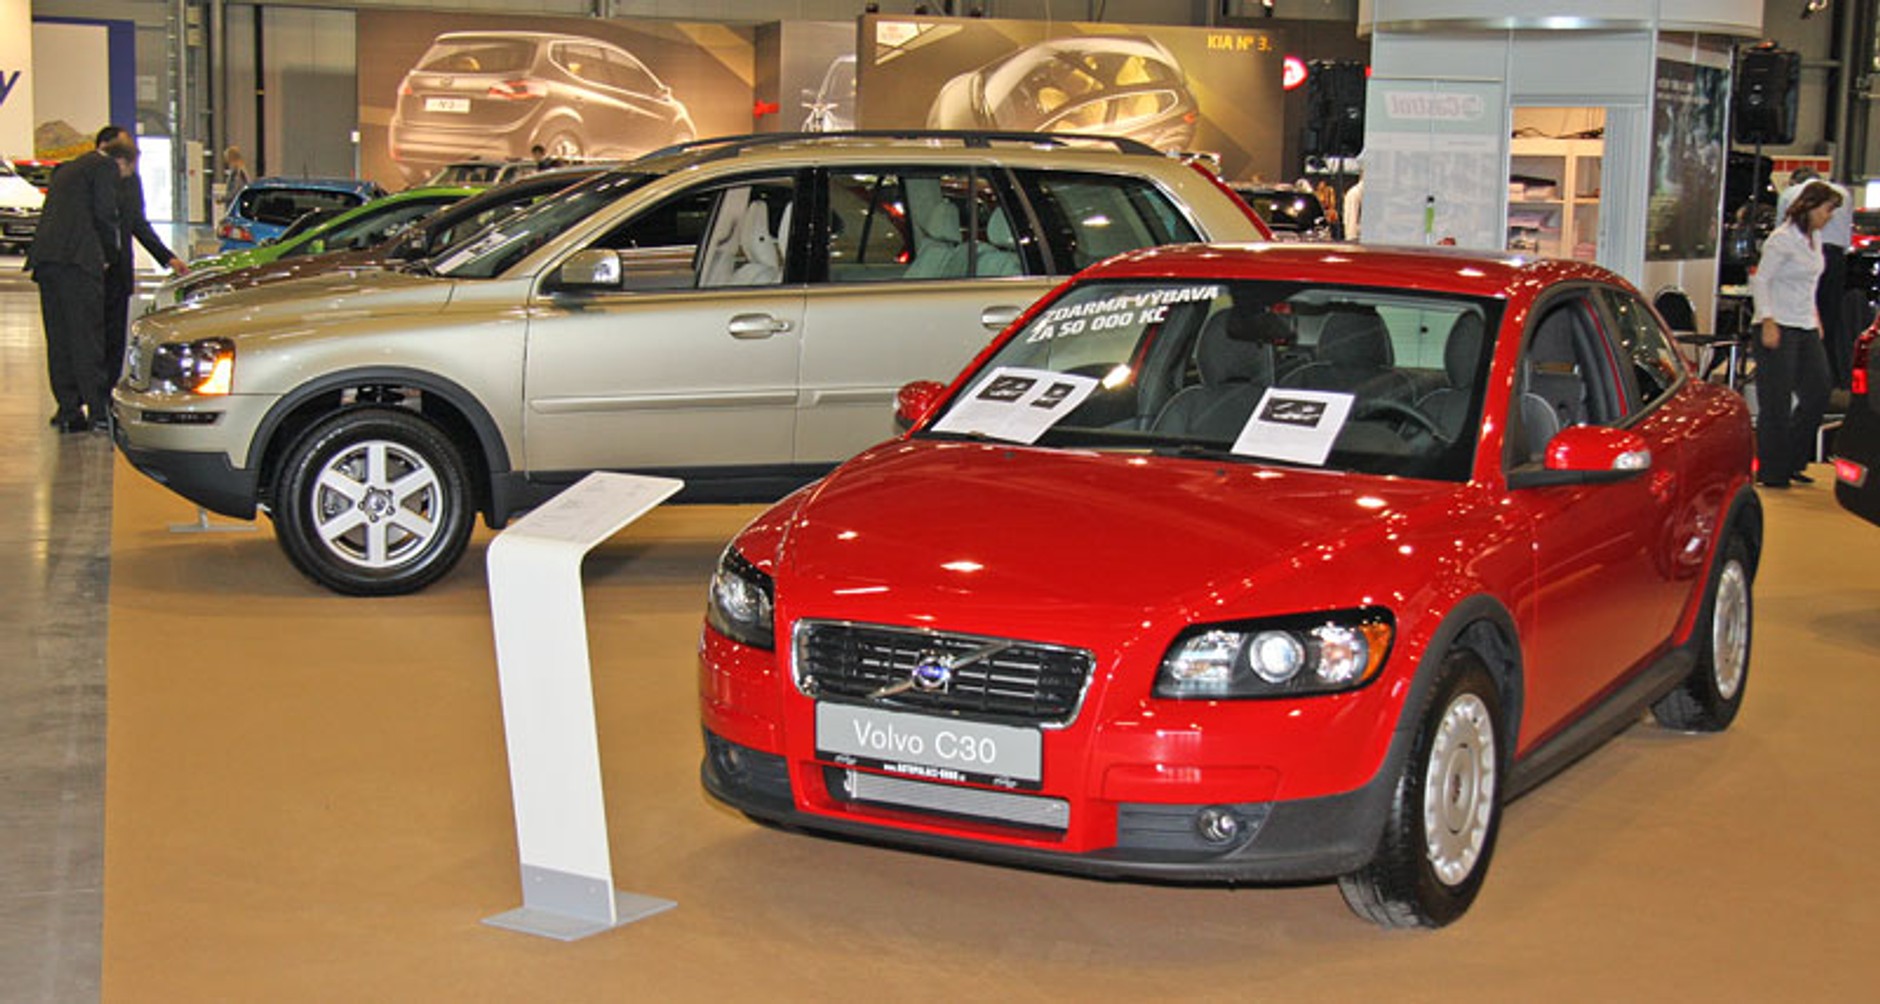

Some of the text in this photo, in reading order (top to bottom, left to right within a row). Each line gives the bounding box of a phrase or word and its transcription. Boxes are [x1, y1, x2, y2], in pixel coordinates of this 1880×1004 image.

[1208, 35, 1232, 49] KIA
[1058, 320, 1087, 338] 50
[1091, 312, 1134, 331] 000
[853, 718, 996, 764] Volvo C30
